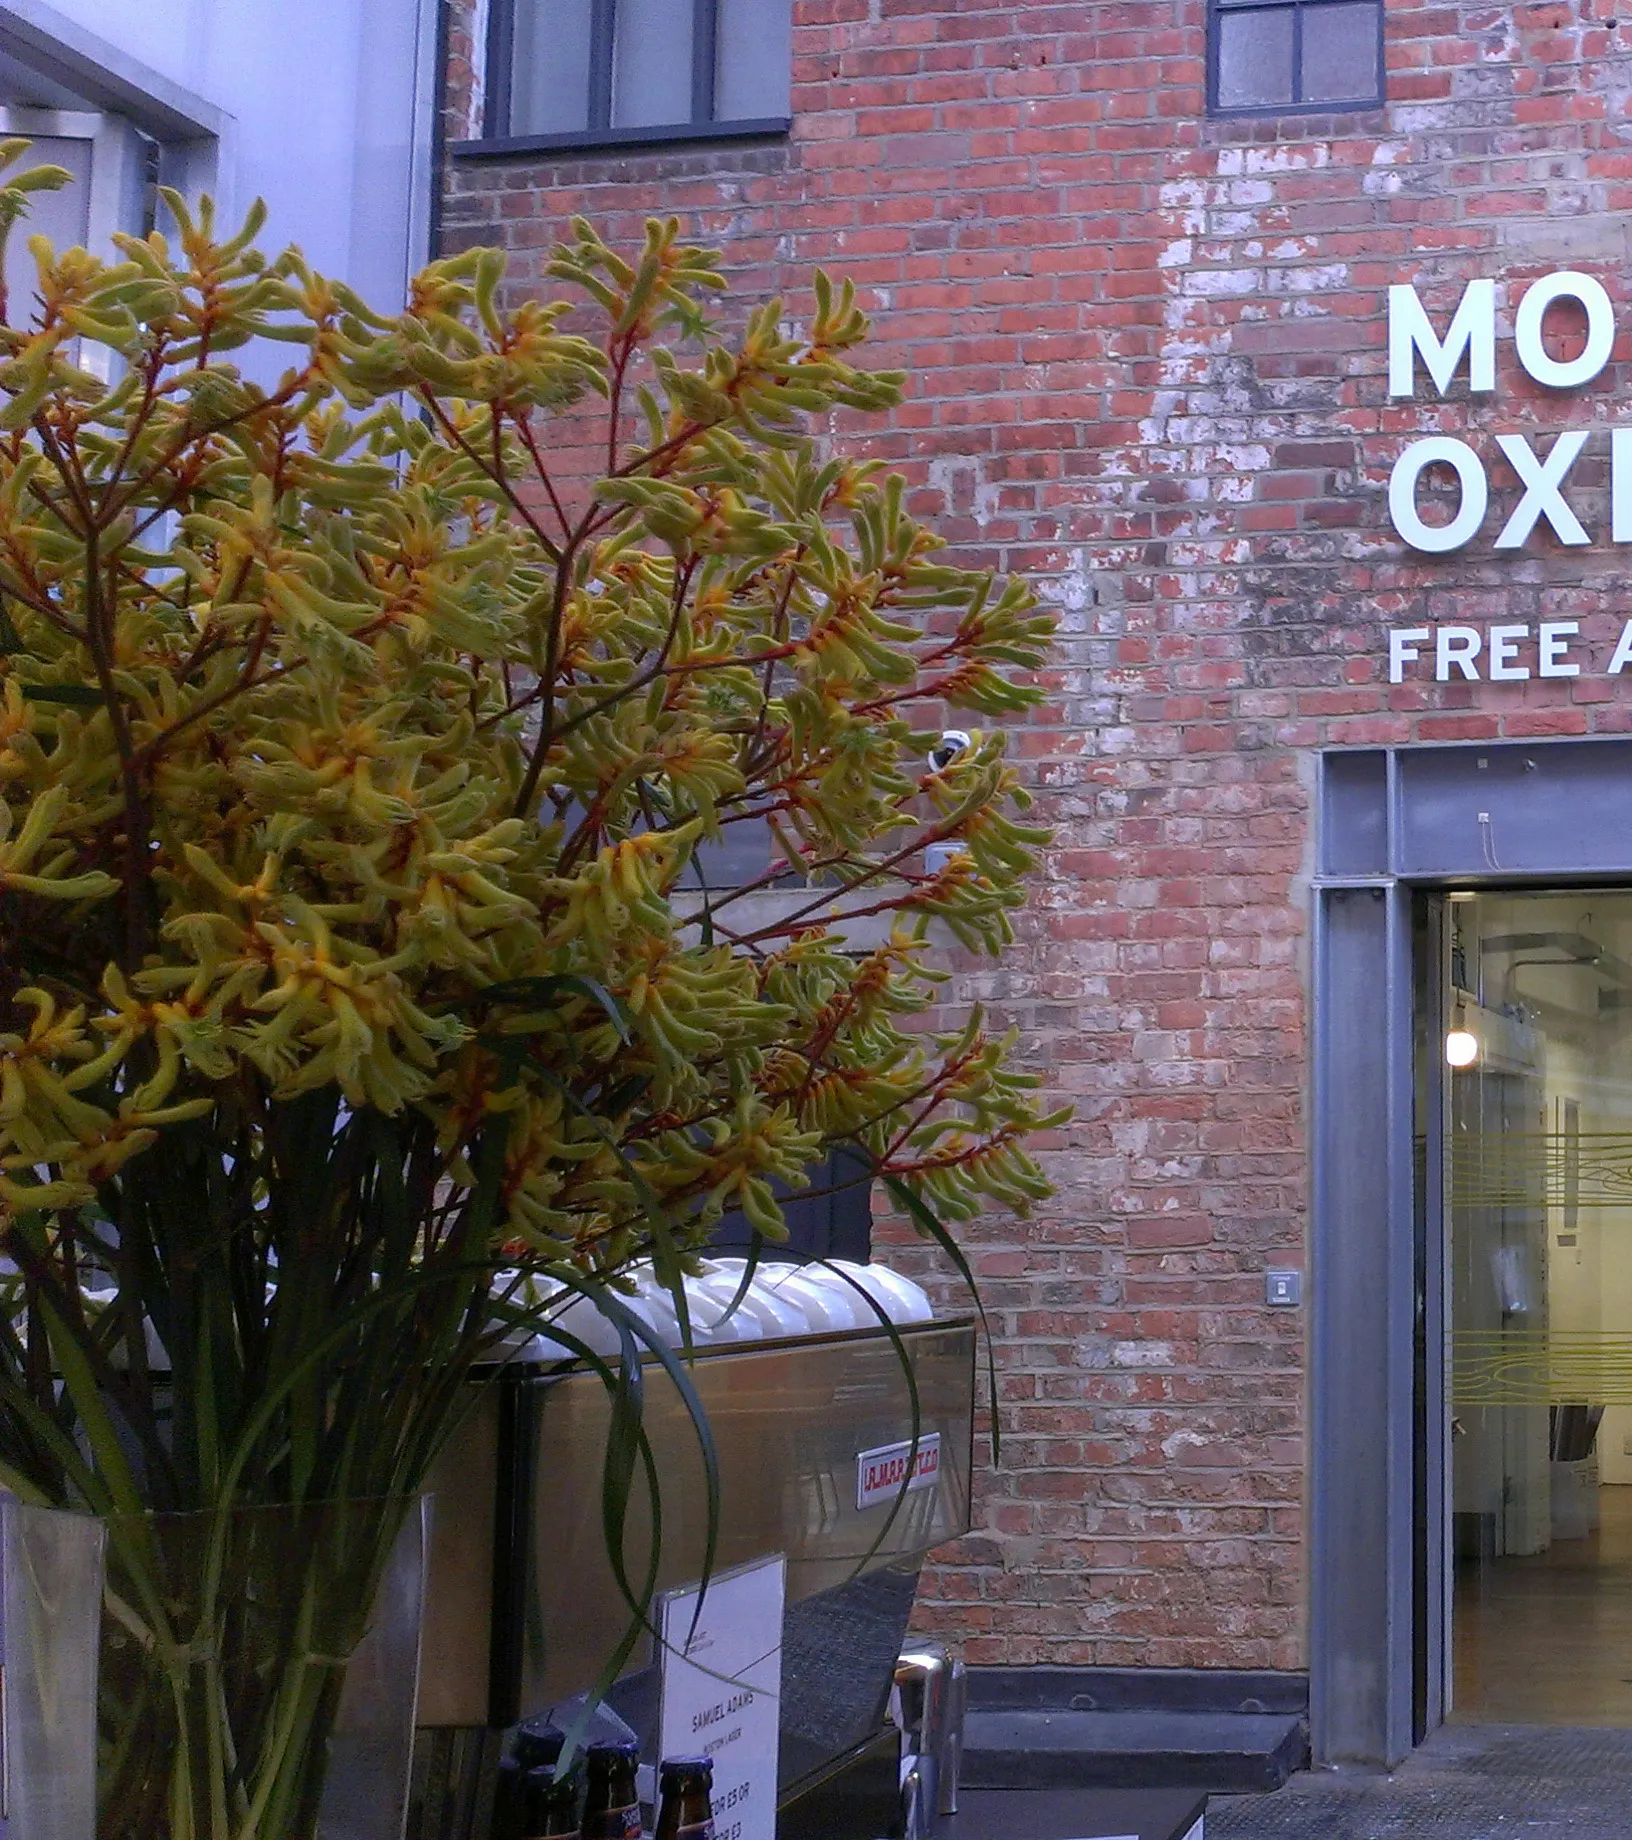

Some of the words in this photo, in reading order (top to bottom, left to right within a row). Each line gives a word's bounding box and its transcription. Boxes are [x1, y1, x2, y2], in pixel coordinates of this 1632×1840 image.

[1389, 622, 1580, 683] FREE
[692, 1702, 725, 1733] SAMUEL
[727, 1692, 753, 1713] ADAMS
[739, 1781, 750, 1801] OR
